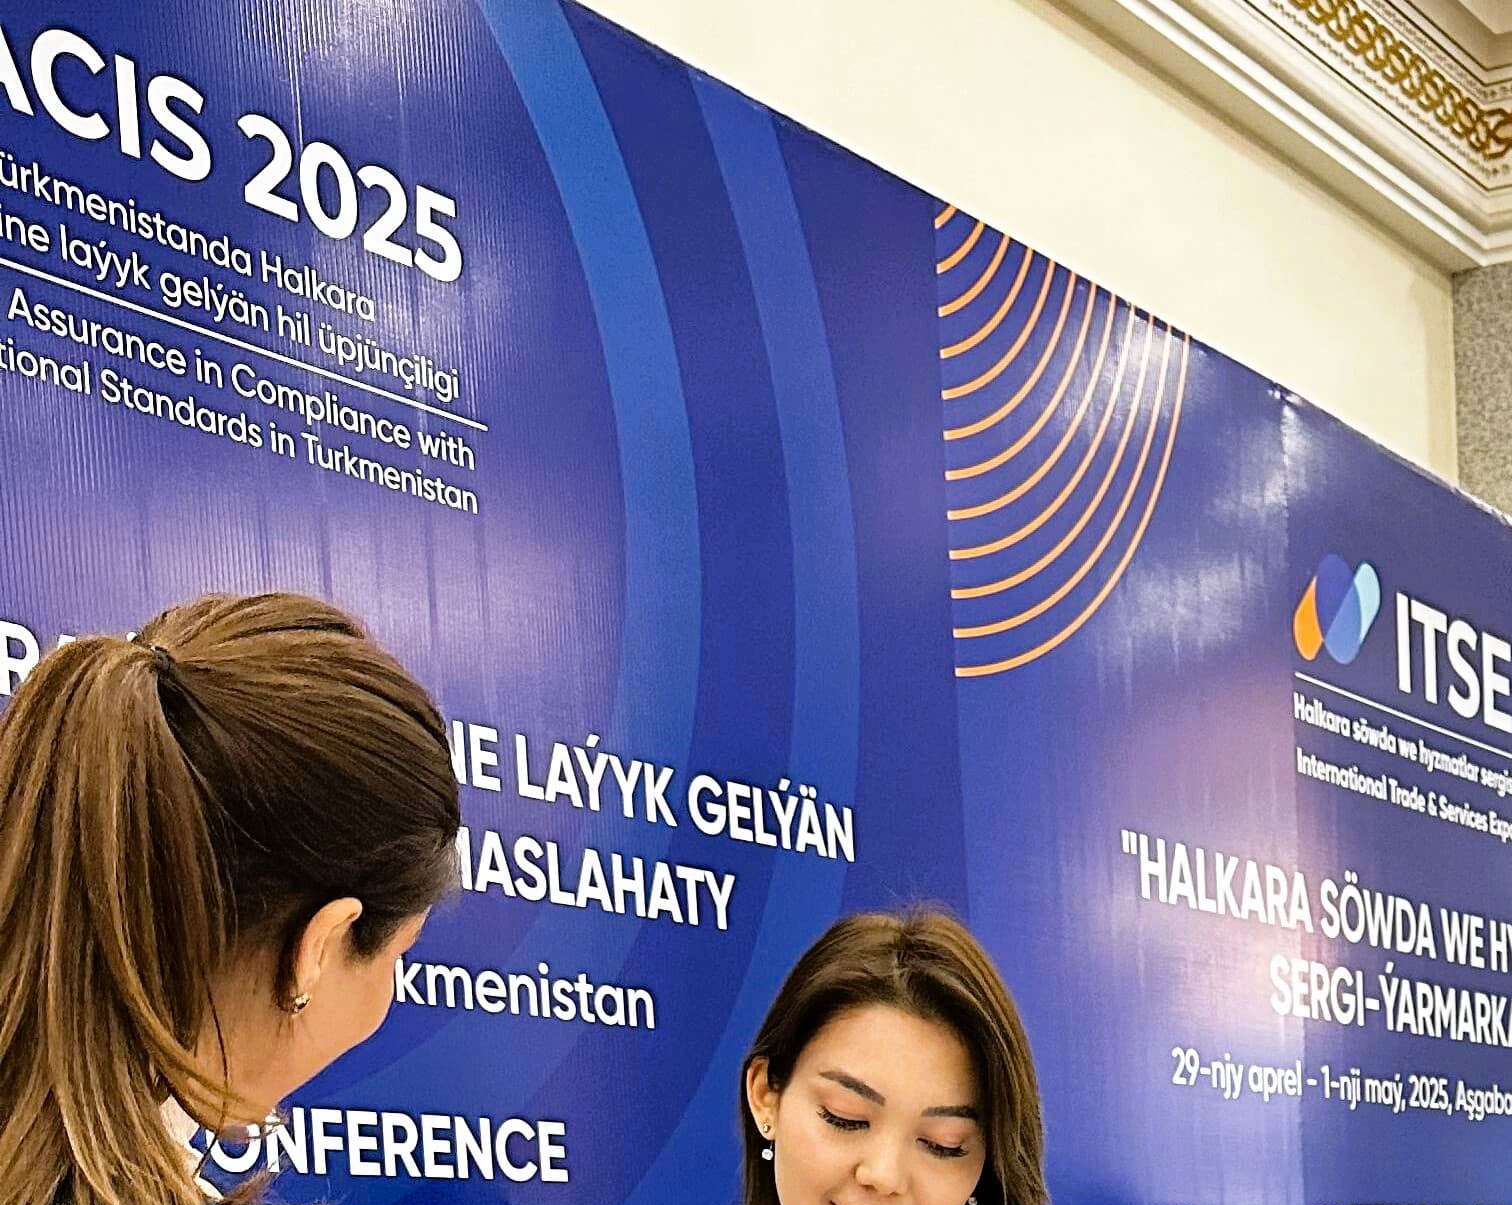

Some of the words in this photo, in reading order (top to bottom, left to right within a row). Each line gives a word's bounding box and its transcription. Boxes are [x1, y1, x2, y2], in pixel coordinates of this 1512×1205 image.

[237, 113, 464, 284] 2025
[60, 223, 151, 290] laýyk
[159, 272, 269, 332] gelýän
[277, 304, 311, 346] hil
[318, 321, 460, 403] üpjünçiligi
[261, 250, 376, 322] Halkara
[7, 287, 187, 375] Assurance
[194, 348, 223, 389] in
[231, 363, 411, 449] Compliance
[416, 431, 475, 470] with
[101, 368, 263, 448] Standards
[269, 421, 296, 458] in
[300, 431, 478, 514] Turkmenistan
[515, 733, 678, 827] LAÝYK
[688, 778, 855, 863] GELÝÄN
[1293, 691, 1350, 737] Halkara
[1352, 717, 1397, 754] söwda
[1398, 736, 1417, 760] we
[1418, 737, 1480, 783] hyzmatlar
[1296, 746, 1388, 800] International
[1388, 778, 1426, 812] Trade
[1427, 791, 1438, 817] &
[1438, 797, 1488, 833] Services
[1121, 829, 1313, 934] "HALKARA
[1320, 870, 1437, 958] SÖWDA
[1441, 906, 1485, 968] WE
[394, 955, 656, 1030] kmenistan
[1171, 1047, 1244, 1100] 29-njy
[1248, 1059, 1302, 1102] aprel
[1320, 1064, 1361, 1111] 1-nji
[1364, 1072, 1406, 1114] maý,
[1407, 1074, 1453, 1115] 2025,
